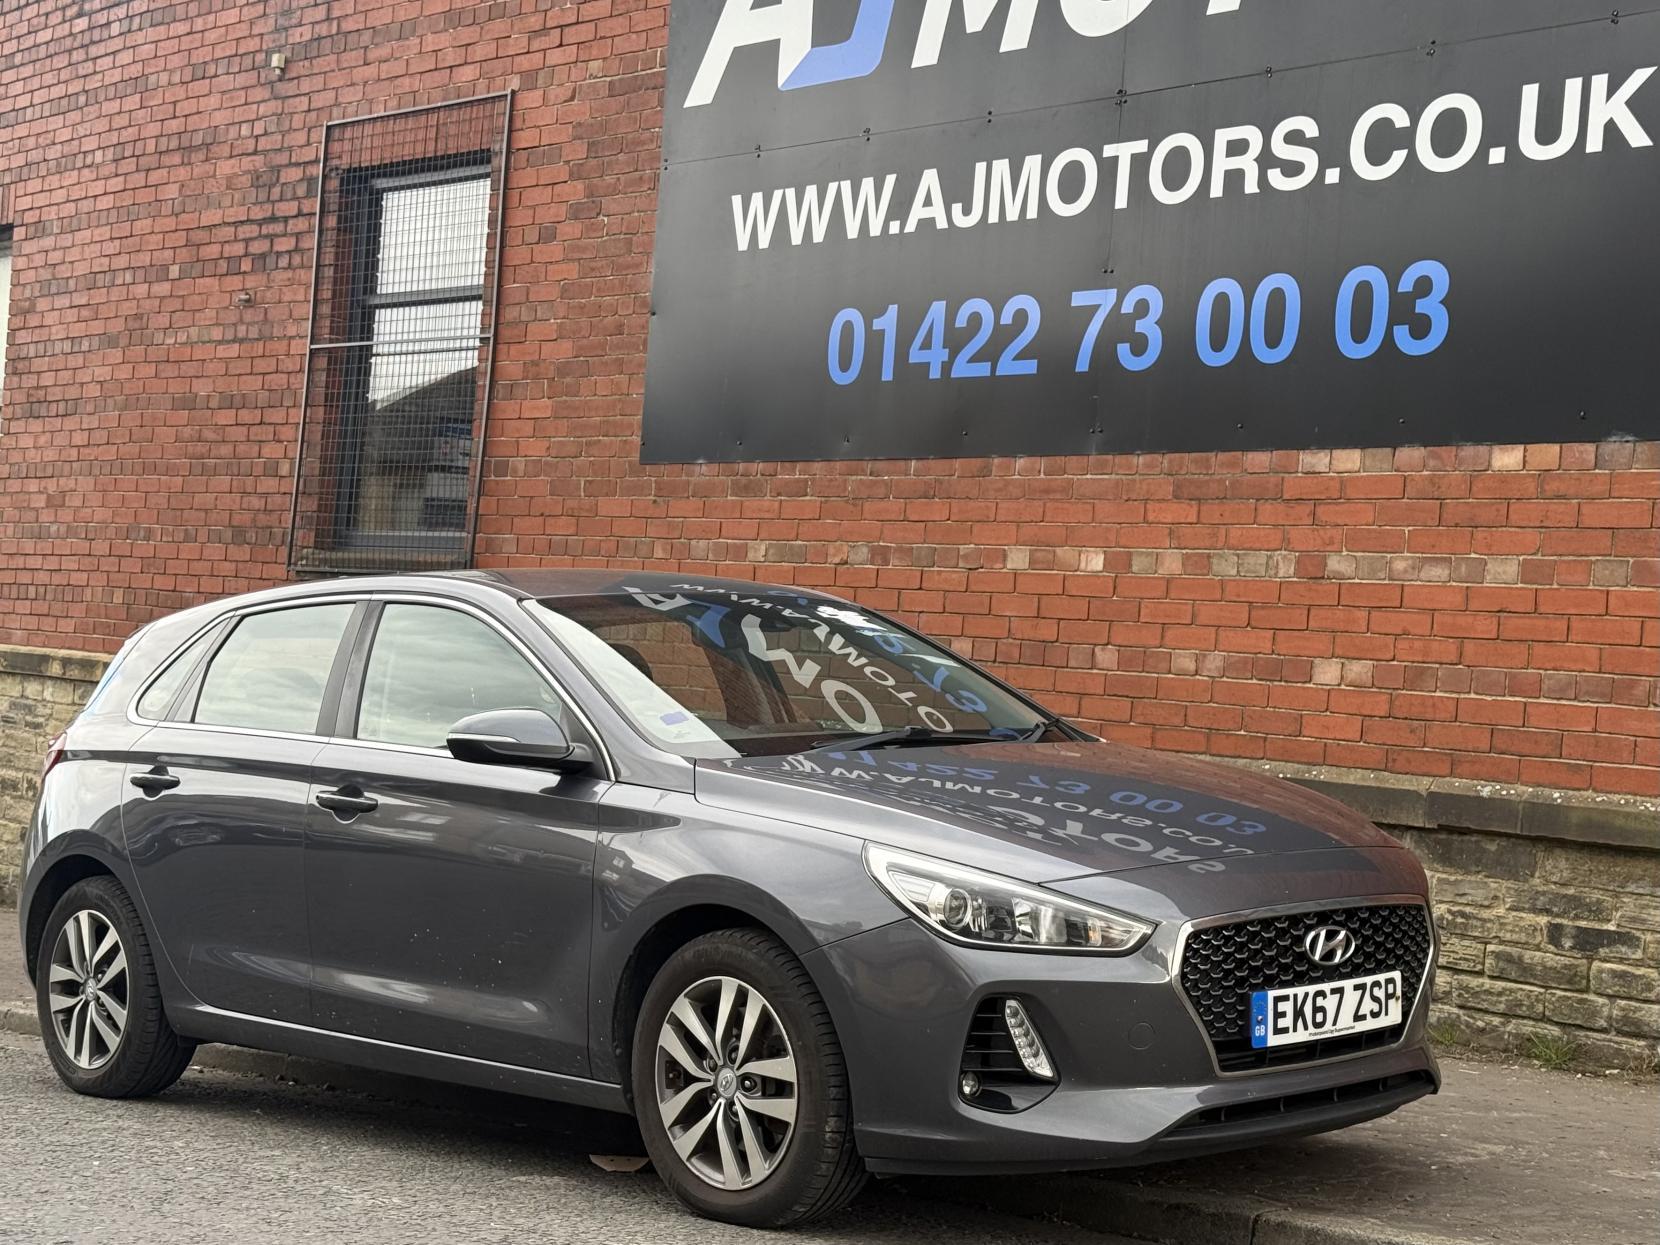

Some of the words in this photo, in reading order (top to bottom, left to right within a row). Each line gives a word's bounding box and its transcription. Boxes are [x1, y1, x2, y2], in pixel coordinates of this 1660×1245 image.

[731, 66, 1658, 252] WWW.AJMOTORS.CO.UK
[827, 294, 1040, 386] 01422
[1071, 284, 1163, 373] 73
[1195, 273, 1302, 368] 00
[1335, 259, 1451, 360] 03
[1255, 1025, 1266, 1037] GB
[1272, 986, 1345, 1036] EK67
[1353, 977, 1398, 1023] ZSP
